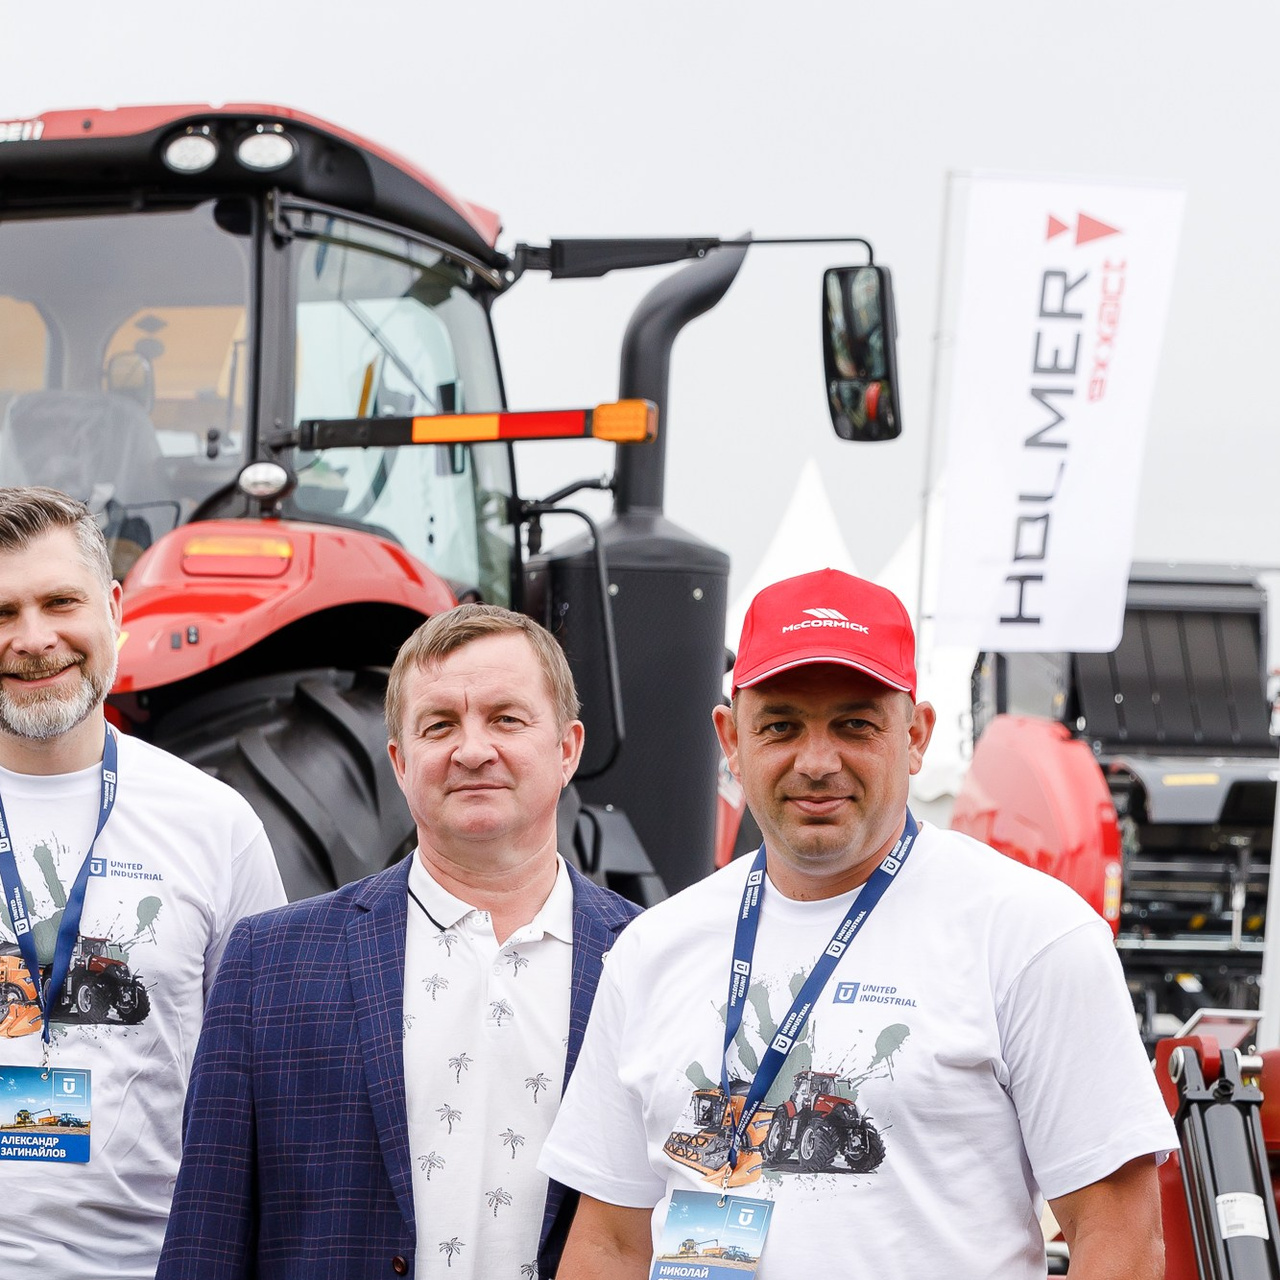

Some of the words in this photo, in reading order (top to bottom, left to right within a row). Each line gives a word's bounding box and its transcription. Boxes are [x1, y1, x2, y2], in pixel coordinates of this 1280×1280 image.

[999, 268, 1089, 624] HOLMER
[782, 619, 869, 635] McCORMICK
[111, 861, 143, 871] UNITED
[110, 870, 163, 881] INDUSTRIAL
[836, 919, 852, 941] UNITED
[842, 910, 867, 943] INDUSTRIAL
[862, 984, 897, 994] UNITED
[859, 994, 917, 1008] INDUSTRIAL
[781, 1012, 797, 1035] UNITED
[788, 1002, 811, 1037] INDUSTRIAL
[1, 1136, 60, 1148] АЛЕКСАНДР
[0, 1145, 66, 1158] ЗАГИНАЙЛОВ
[659, 1266, 709, 1279] НИКОЛАЙ
